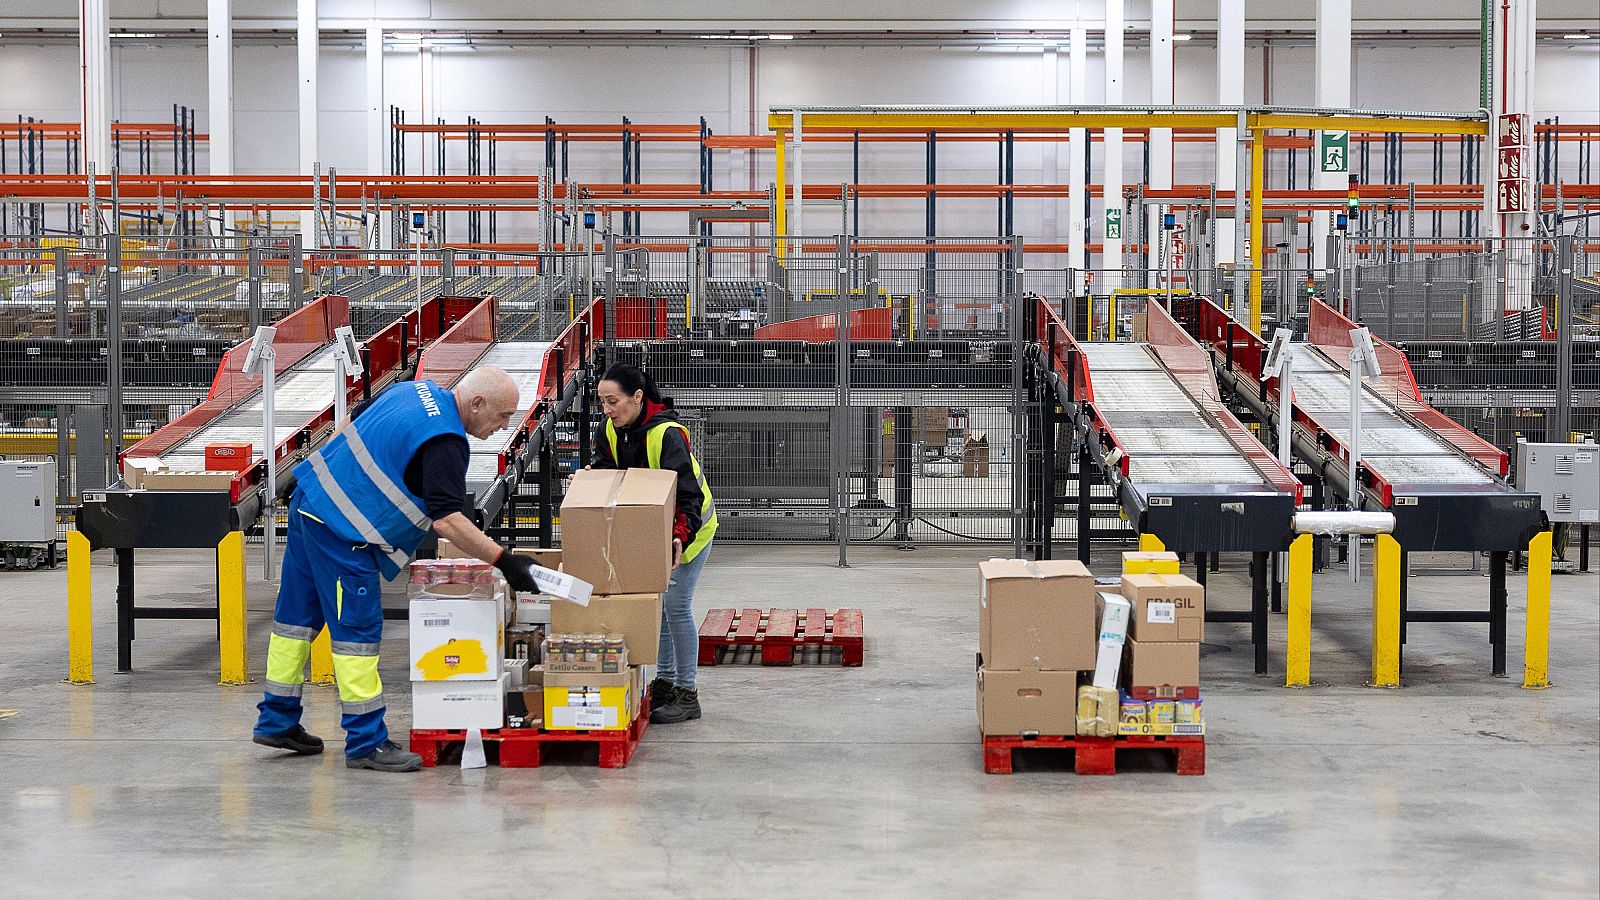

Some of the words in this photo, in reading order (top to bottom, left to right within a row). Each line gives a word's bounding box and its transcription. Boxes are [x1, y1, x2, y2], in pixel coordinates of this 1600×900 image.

[414, 382, 441, 417] AYUDANTE
[549, 663, 571, 672] Estilo
[572, 663, 597, 672] Casero
